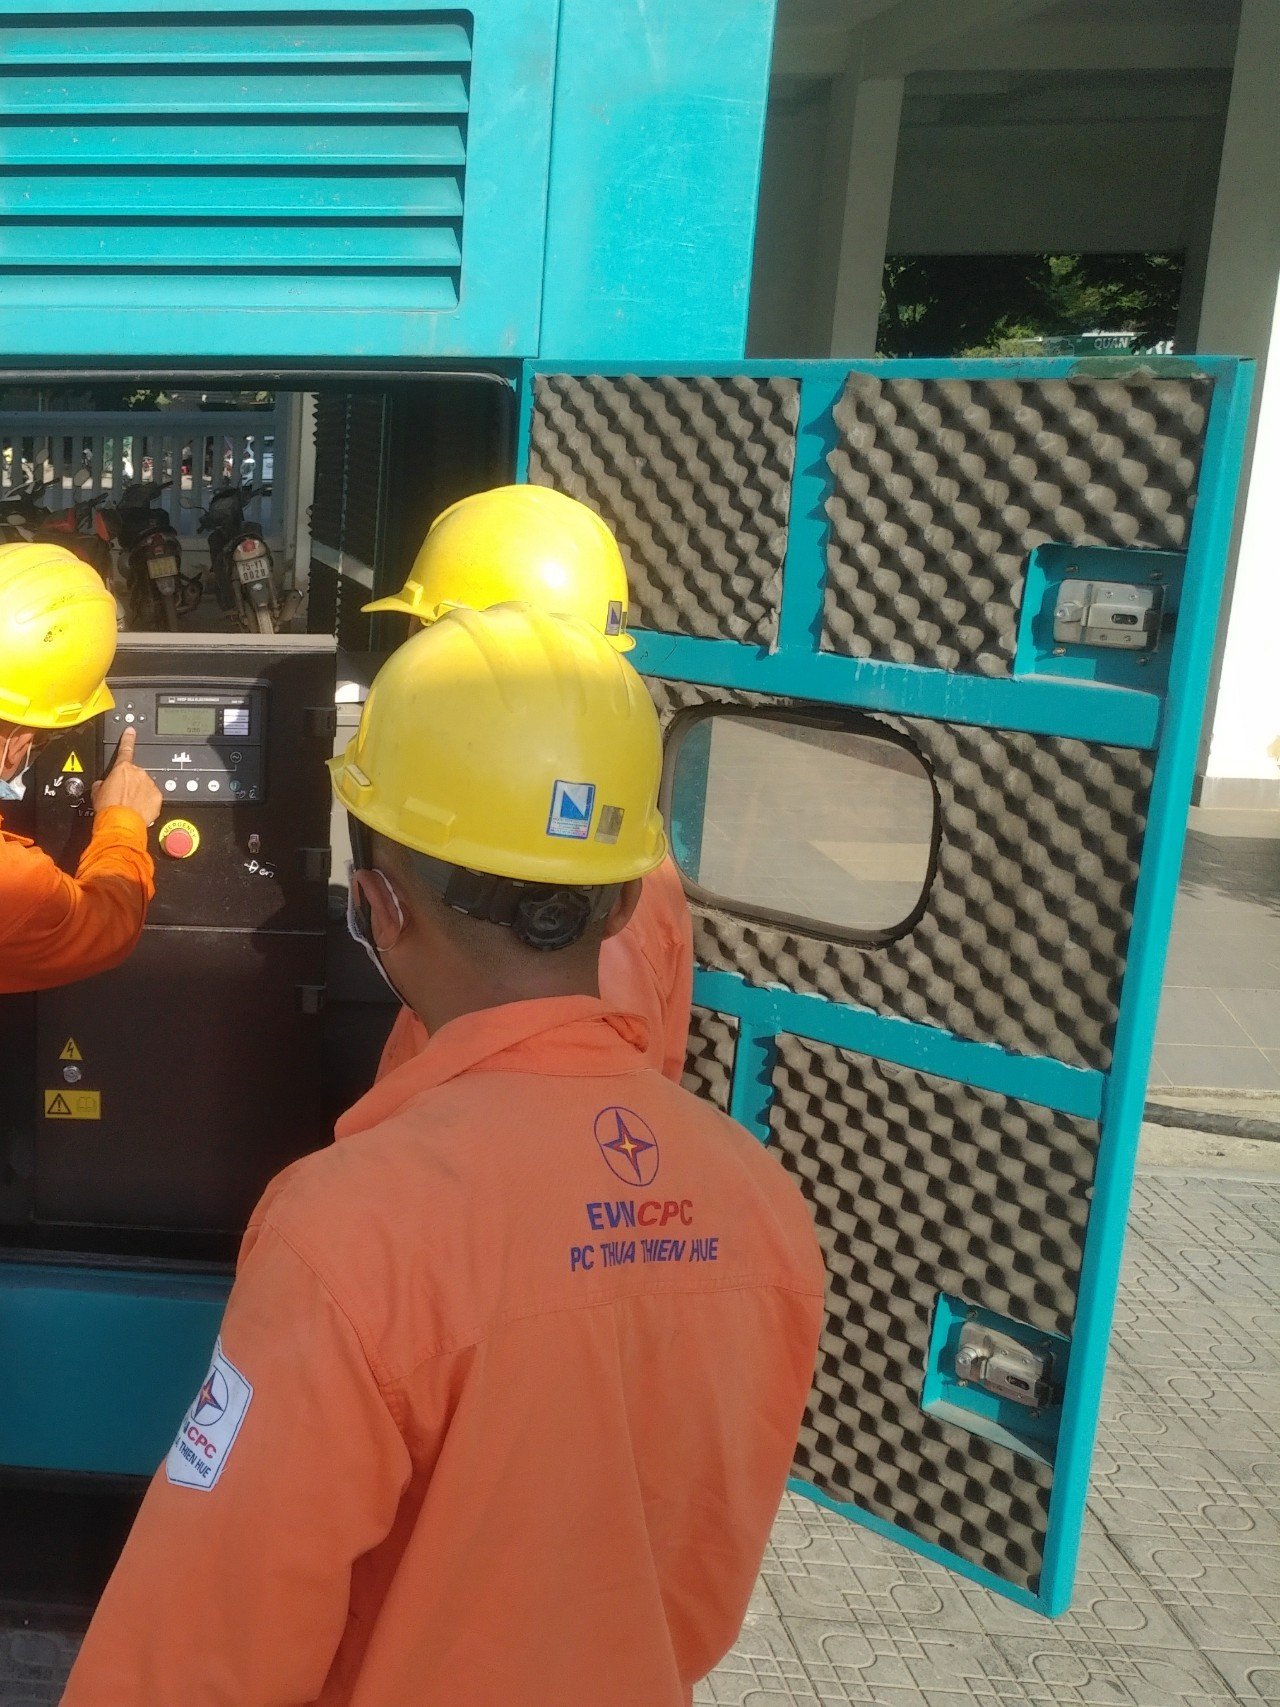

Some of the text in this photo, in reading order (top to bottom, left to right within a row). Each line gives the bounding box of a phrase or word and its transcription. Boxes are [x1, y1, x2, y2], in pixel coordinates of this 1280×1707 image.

[586, 1199, 694, 1231] EVNCPC
[570, 1237, 719, 1272] PC THUA THIEN HUE
[178, 1440, 196, 1466] THIEN
[195, 1458, 212, 1479] HUE
